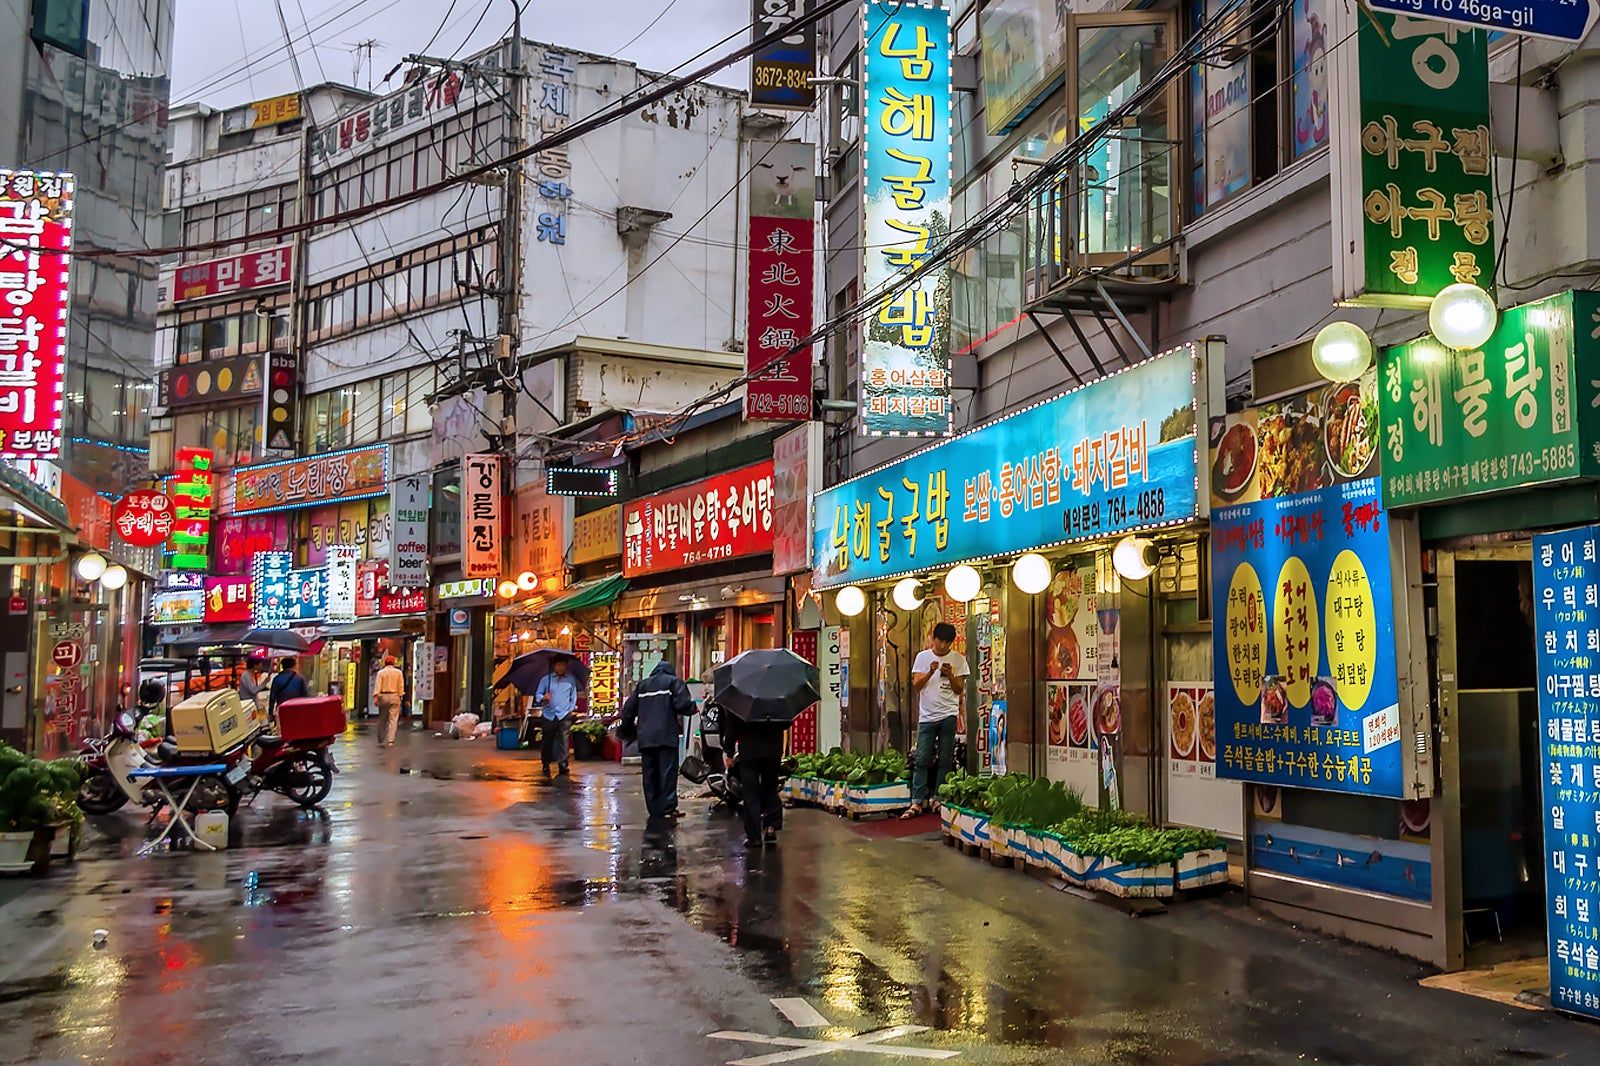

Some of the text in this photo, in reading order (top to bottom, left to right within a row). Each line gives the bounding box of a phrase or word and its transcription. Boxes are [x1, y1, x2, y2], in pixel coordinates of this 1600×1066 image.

[1458, 3, 1533, 26] 46ga-gil
[1362, 114, 1489, 176] 아구찜
[880, 22, 937, 349] 남해굴국밥
[1364, 183, 1493, 245] 아구탕
[216, 250, 287, 292] 만화
[760, 227, 801, 383] 東北火鍋王
[272, 356, 296, 368] sbs
[870, 368, 945, 388] 홍어삼합
[870, 396, 946, 416] 돼지갈비
[1386, 356, 1405, 463] 청정
[1409, 332, 1544, 447] 해물탕
[12, 431, 54, 452] 보쌈
[1511, 443, 1575, 477] 743-5885
[962, 419, 1149, 523] 보쌈·홍어삼합·돼지갈비
[653, 475, 775, 552] 민물매운탕·추어탕
[832, 468, 950, 572] 남해굴국밥
[1107, 487, 1165, 527] 764-4858
[397, 541, 426, 553] coffee
[399, 557, 424, 569] beer
[682, 544, 732, 565] 764-4718
[1325, 731, 1361, 747] 요구르트
